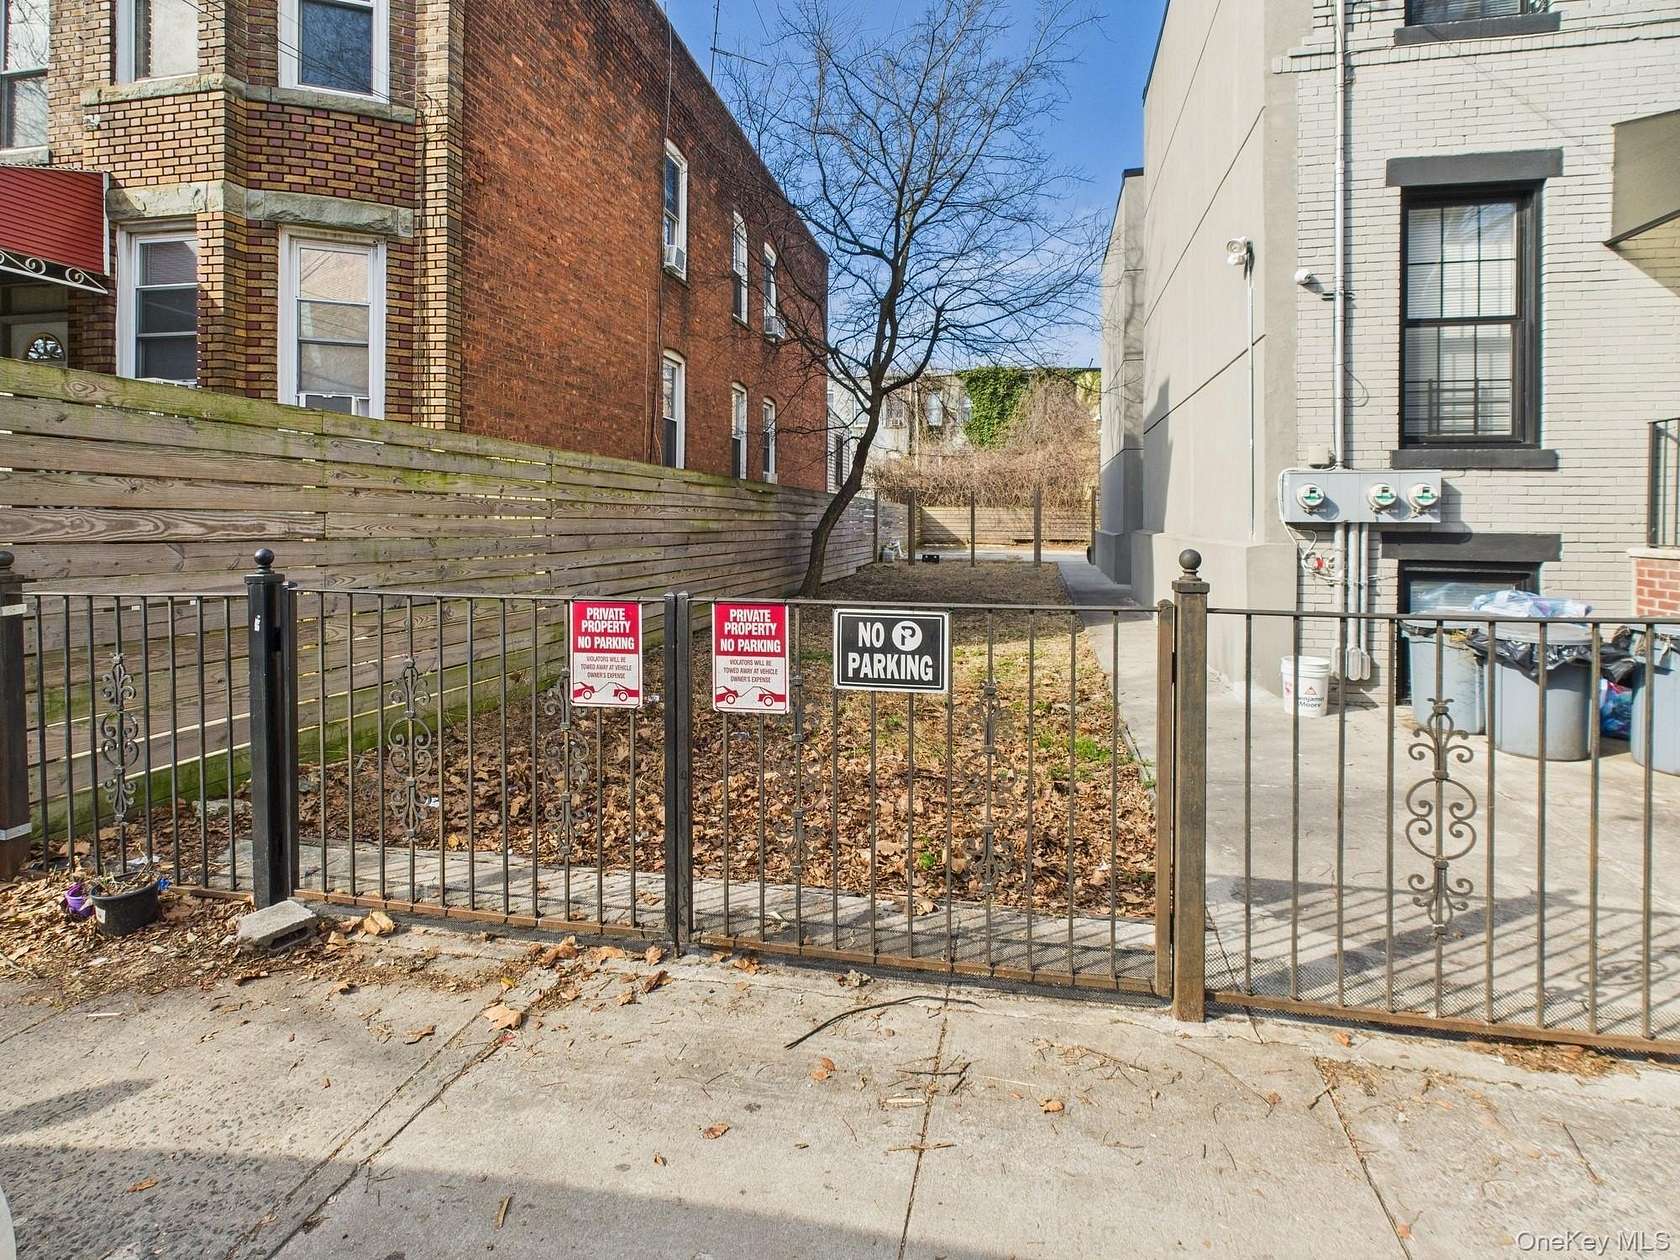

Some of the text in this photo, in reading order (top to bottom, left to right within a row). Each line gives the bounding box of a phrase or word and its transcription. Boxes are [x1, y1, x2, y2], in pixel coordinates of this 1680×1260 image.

[586, 607, 626, 620] PRIVATE
[729, 609, 771, 622] PRIVATE
[581, 620, 631, 633] PROPERTY
[724, 622, 777, 636] PROPERTY
[858, 622, 885, 648] NO
[577, 636, 635, 650] NO PARKING
[720, 638, 781, 653] NO PARKING
[847, 652, 933, 681] PARKING
